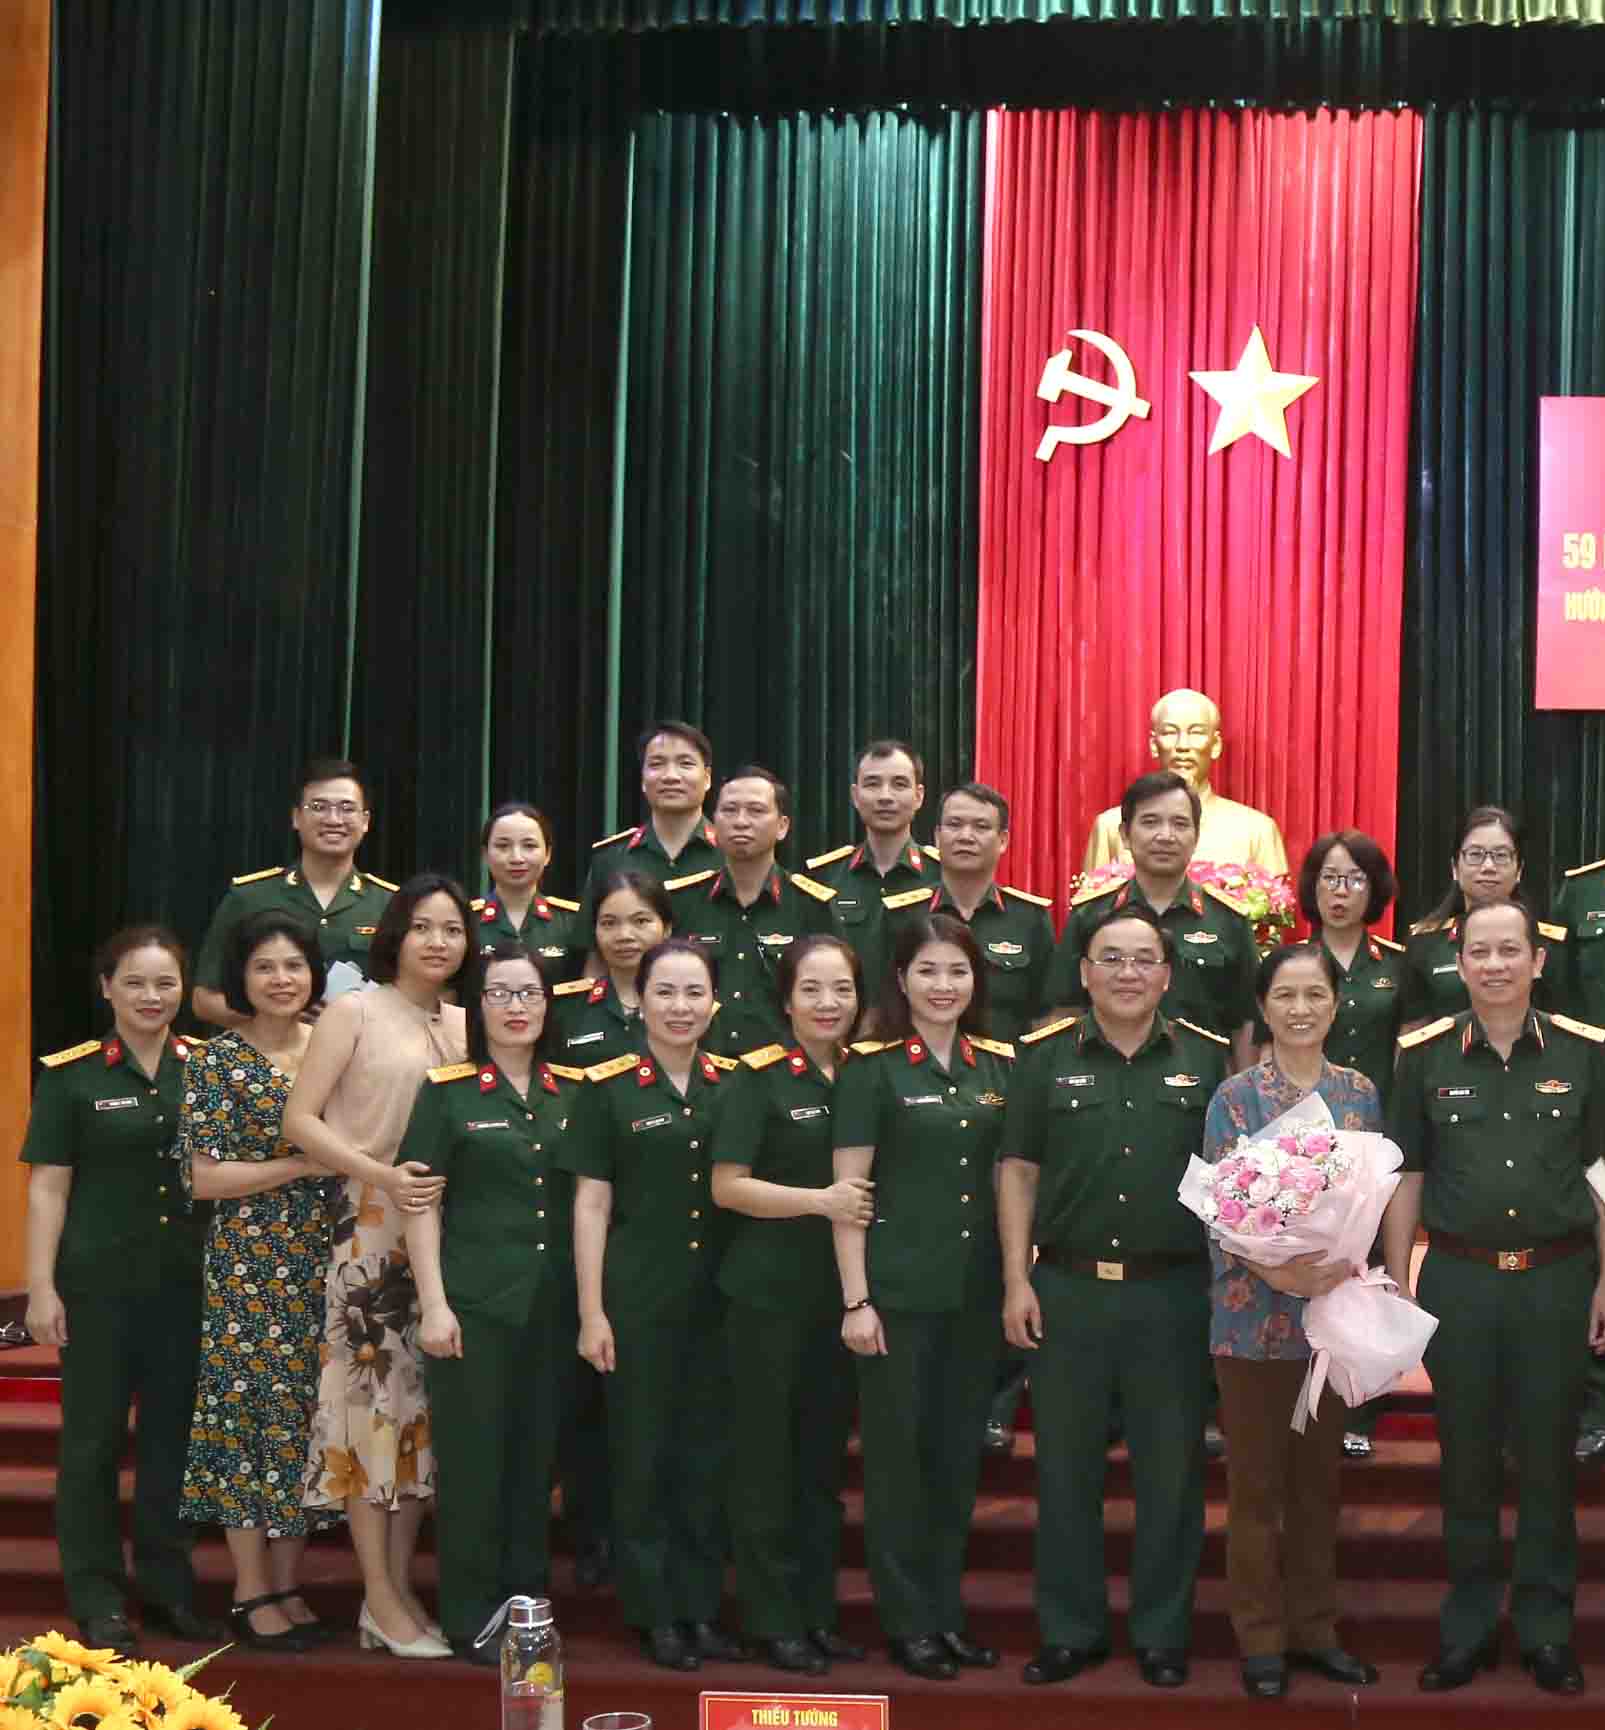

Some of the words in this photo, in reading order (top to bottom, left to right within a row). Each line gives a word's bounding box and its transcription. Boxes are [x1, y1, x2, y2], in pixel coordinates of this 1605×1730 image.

[1563, 533, 1596, 569] 59
[752, 1704, 790, 1726] THIẾU
[793, 1708, 838, 1727] TƯỚNG
